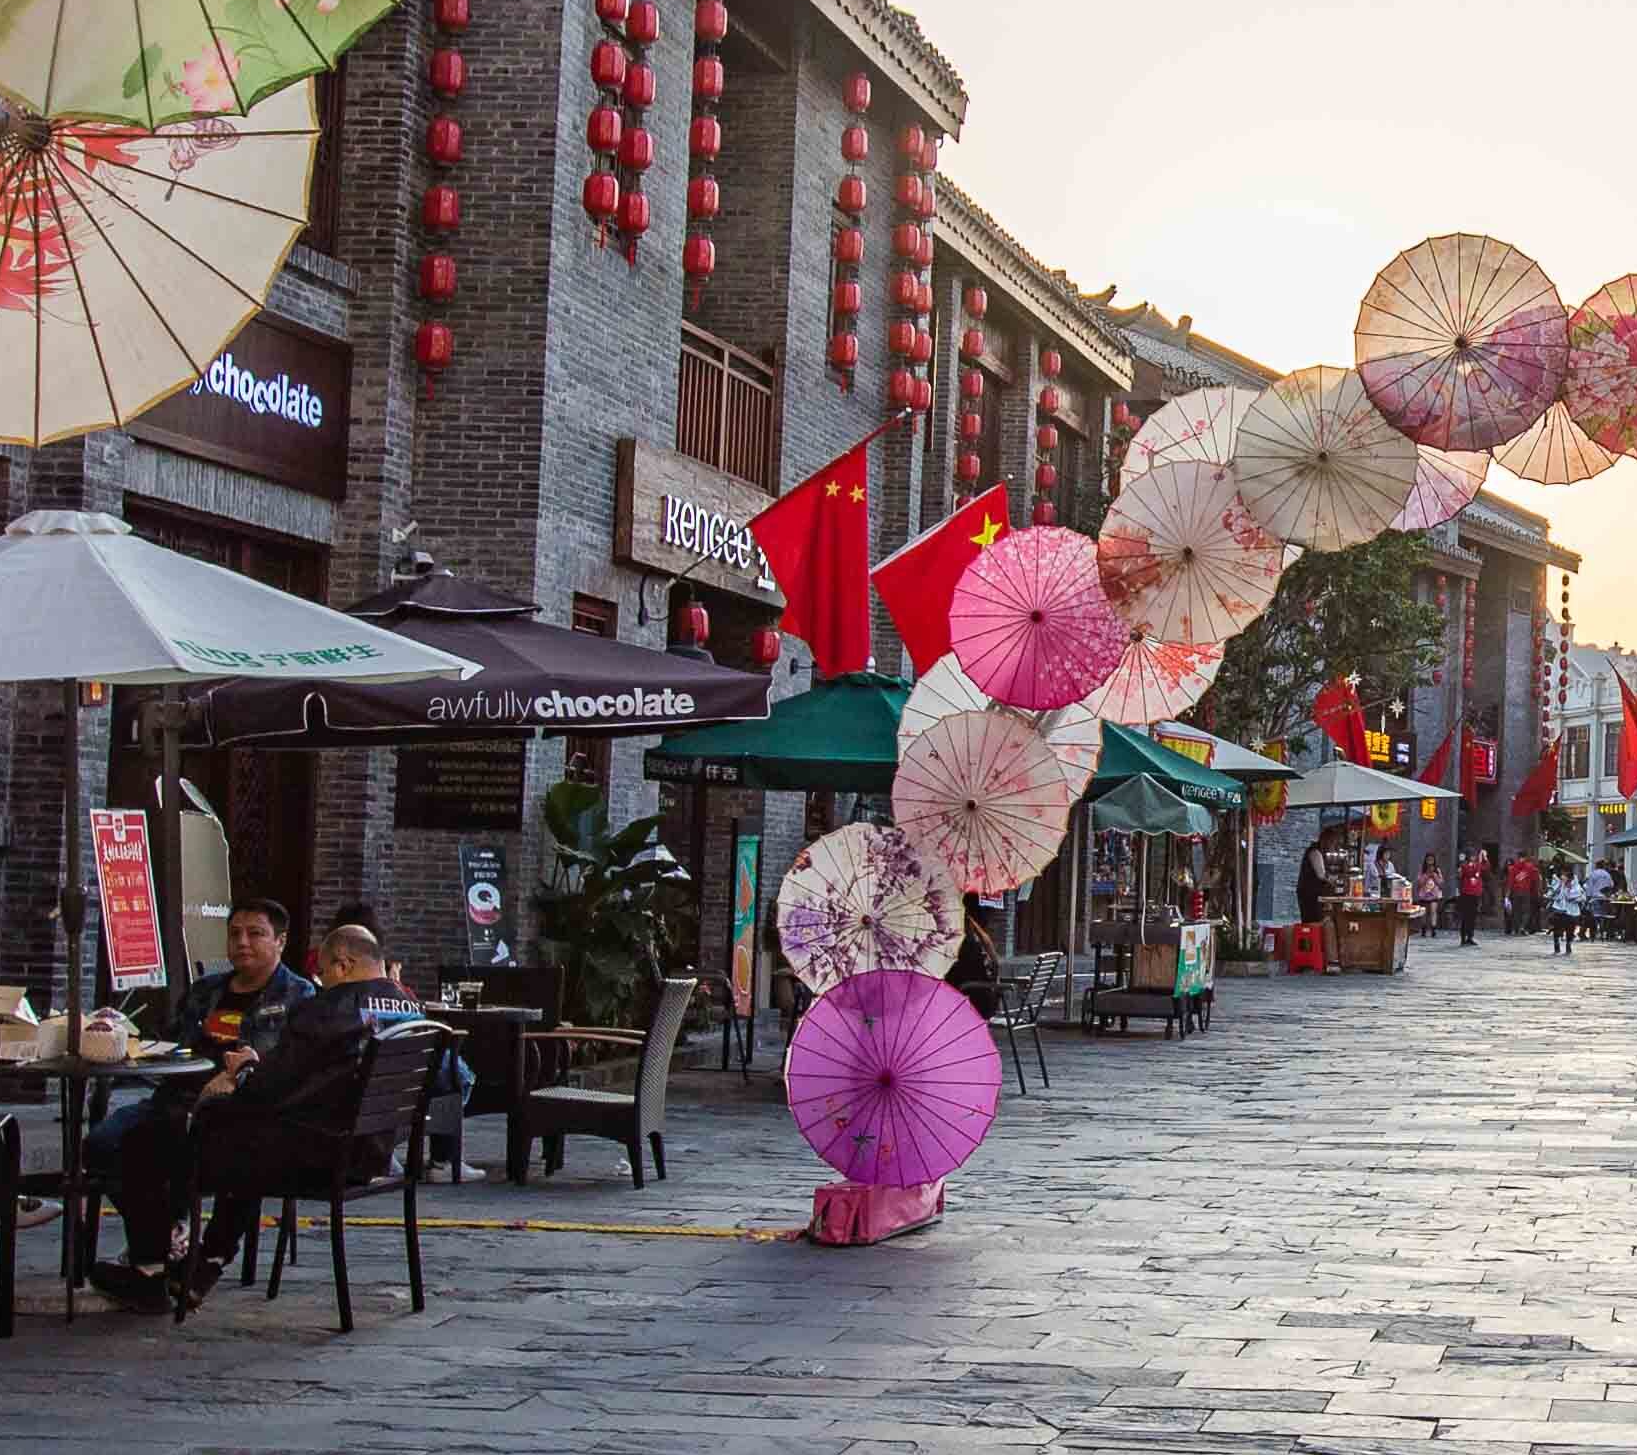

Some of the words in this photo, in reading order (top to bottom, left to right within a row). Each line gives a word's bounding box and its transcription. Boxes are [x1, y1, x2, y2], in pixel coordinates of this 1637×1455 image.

[209, 352, 322, 428] chocolate
[258, 643, 385, 668] 宁家鲜生
